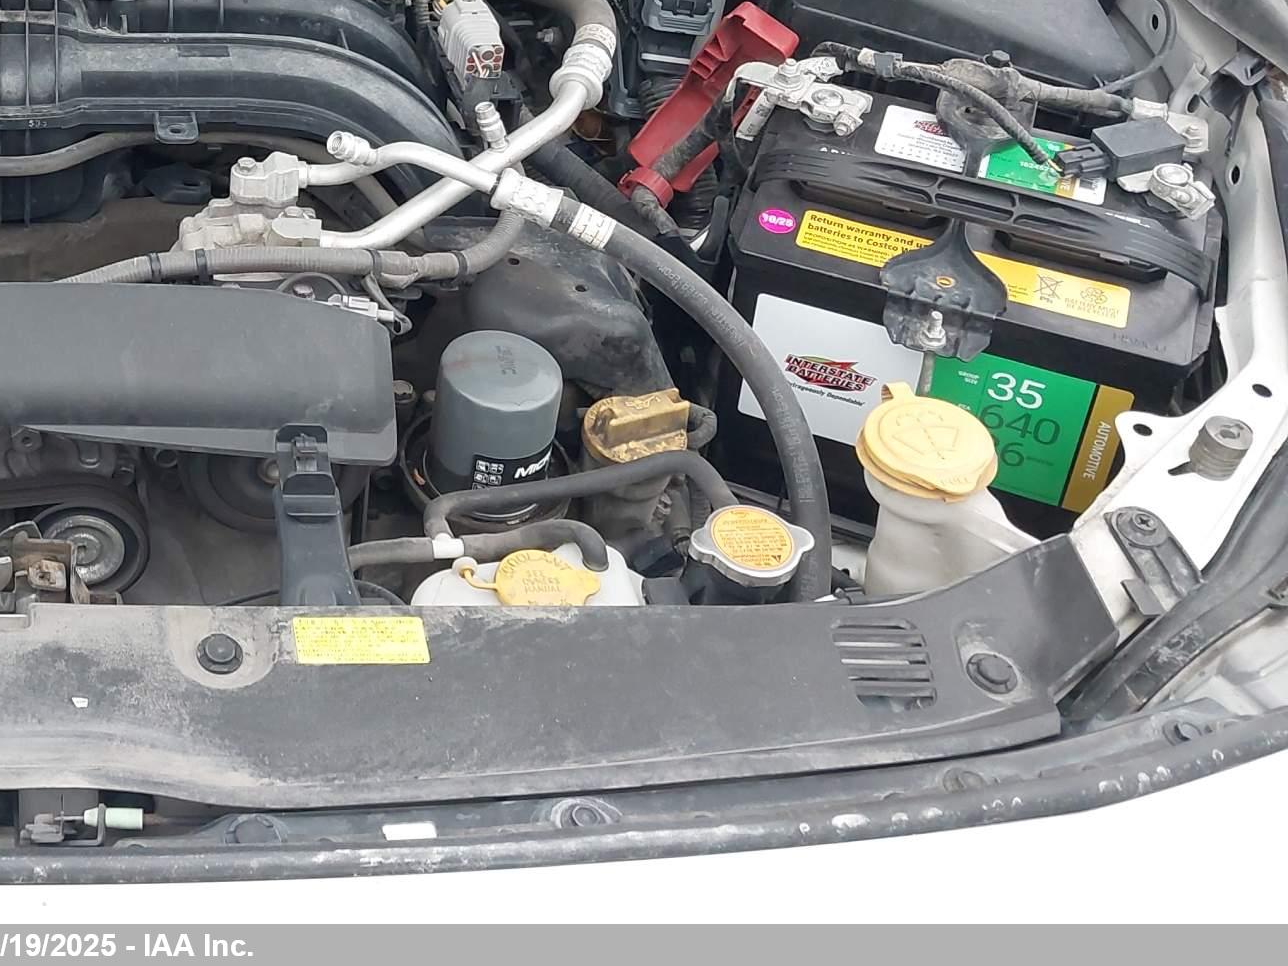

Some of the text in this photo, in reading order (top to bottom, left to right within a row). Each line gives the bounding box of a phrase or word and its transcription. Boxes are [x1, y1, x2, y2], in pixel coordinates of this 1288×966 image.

[807, 222, 852, 241] batteries
[853, 235, 864, 243] to
[865, 238, 899, 252] Costco
[809, 214, 844, 229] Return
[846, 224, 893, 242] warranty
[893, 236, 914, 247] and
[785, 355, 875, 386] INTERSTATE
[785, 364, 866, 391] BATTERIES
[987, 372, 1047, 410] 35
[980, 404, 1061, 446] 640
[1082, 420, 1112, 481] AUTOMOTIVE
[499, 552, 574, 576] COOLANT
